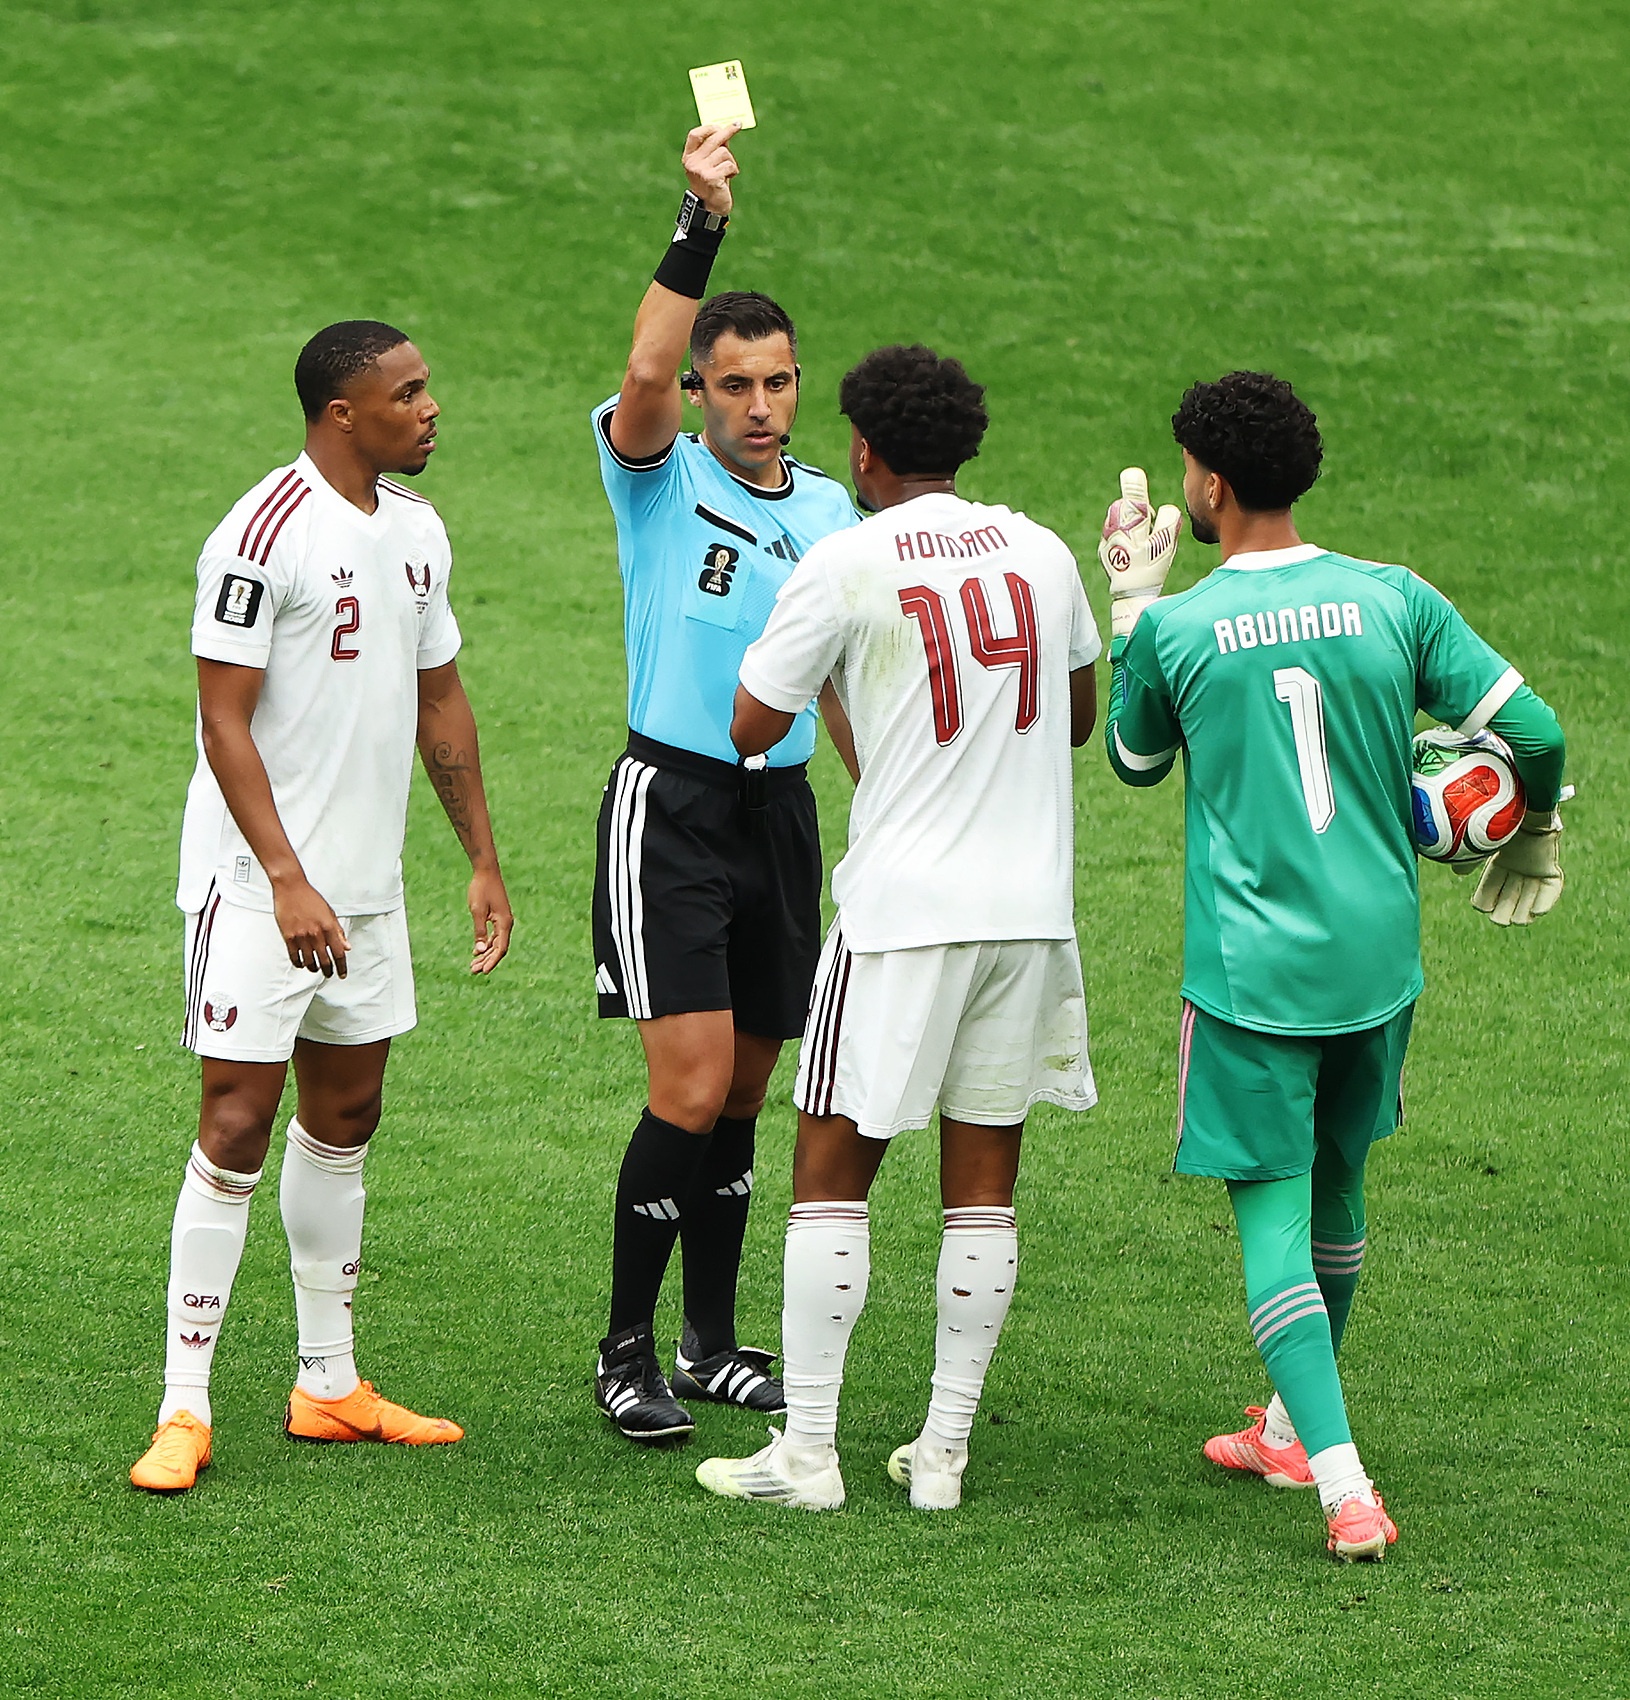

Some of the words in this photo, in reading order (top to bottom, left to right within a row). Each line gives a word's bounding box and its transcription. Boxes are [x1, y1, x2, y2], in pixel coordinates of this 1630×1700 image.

[894, 525, 1009, 561] HOMAM
[330, 596, 362, 662] 2
[1213, 602, 1363, 655] ABUNADA
[898, 572, 1042, 748] 14
[1272, 666, 1337, 835] 1
[183, 1293, 220, 1309] QFA
